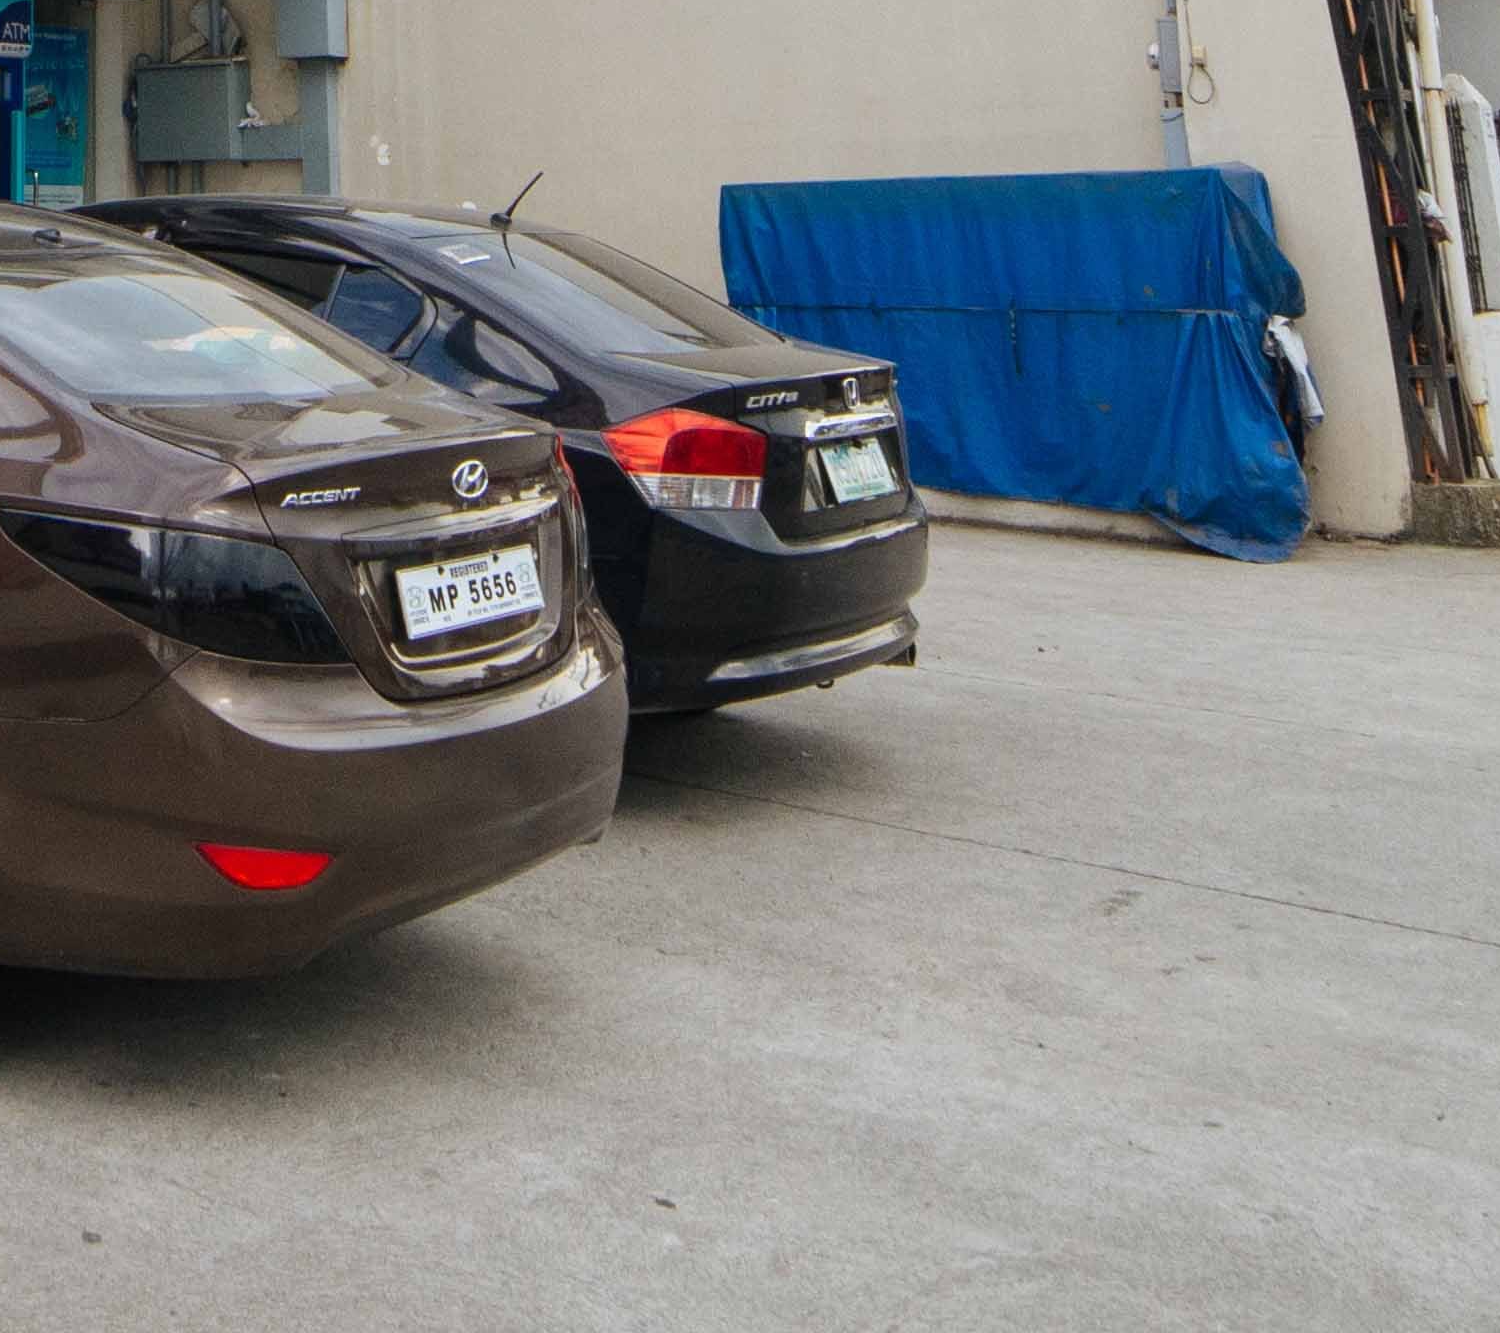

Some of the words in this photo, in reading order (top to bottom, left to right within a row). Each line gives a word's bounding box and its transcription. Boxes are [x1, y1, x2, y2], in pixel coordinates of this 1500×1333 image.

[2, 21, 31, 41] ATM
[279, 486, 361, 509] ACCENT
[449, 560, 489, 578] REGISTERED
[428, 583, 459, 614] MP
[468, 570, 518, 605] 5656
